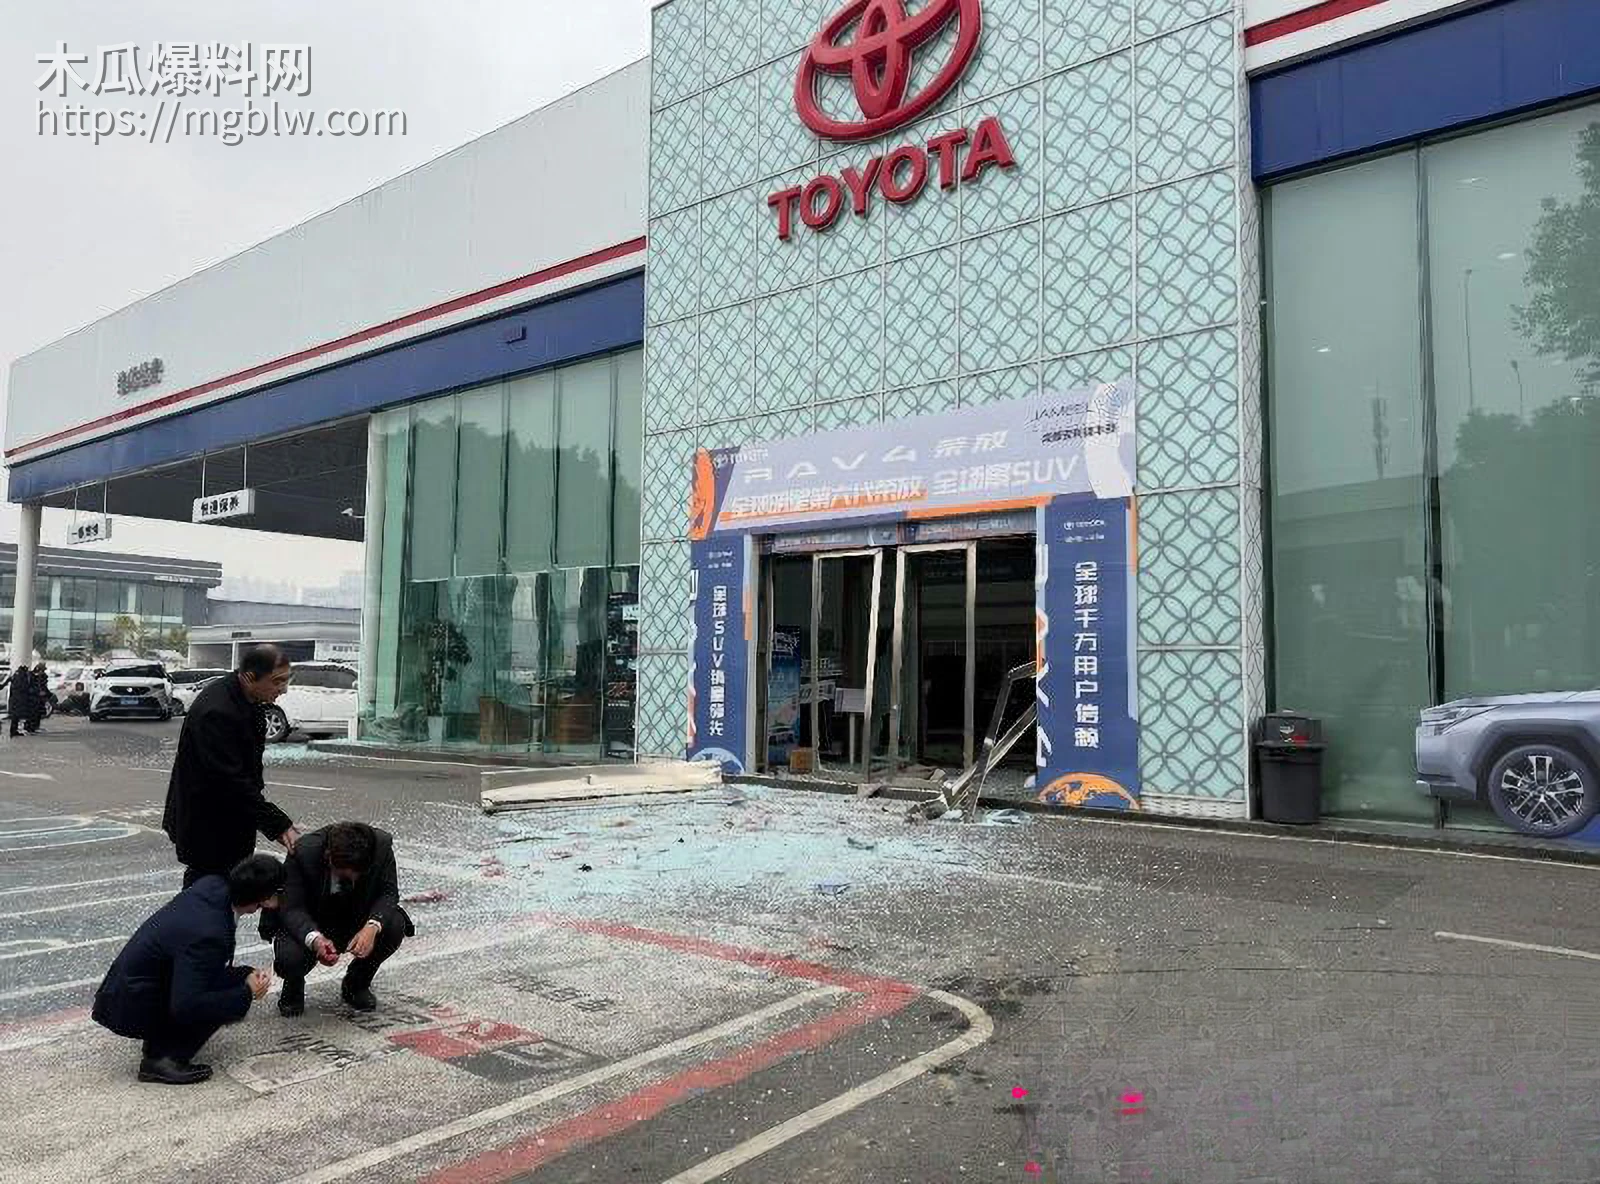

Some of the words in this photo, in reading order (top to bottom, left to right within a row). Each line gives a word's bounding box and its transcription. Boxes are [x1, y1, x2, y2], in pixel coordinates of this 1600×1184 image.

[767, 116, 1015, 241] TOYOTA
[1073, 561, 1099, 748] 全球千万用户信赖
